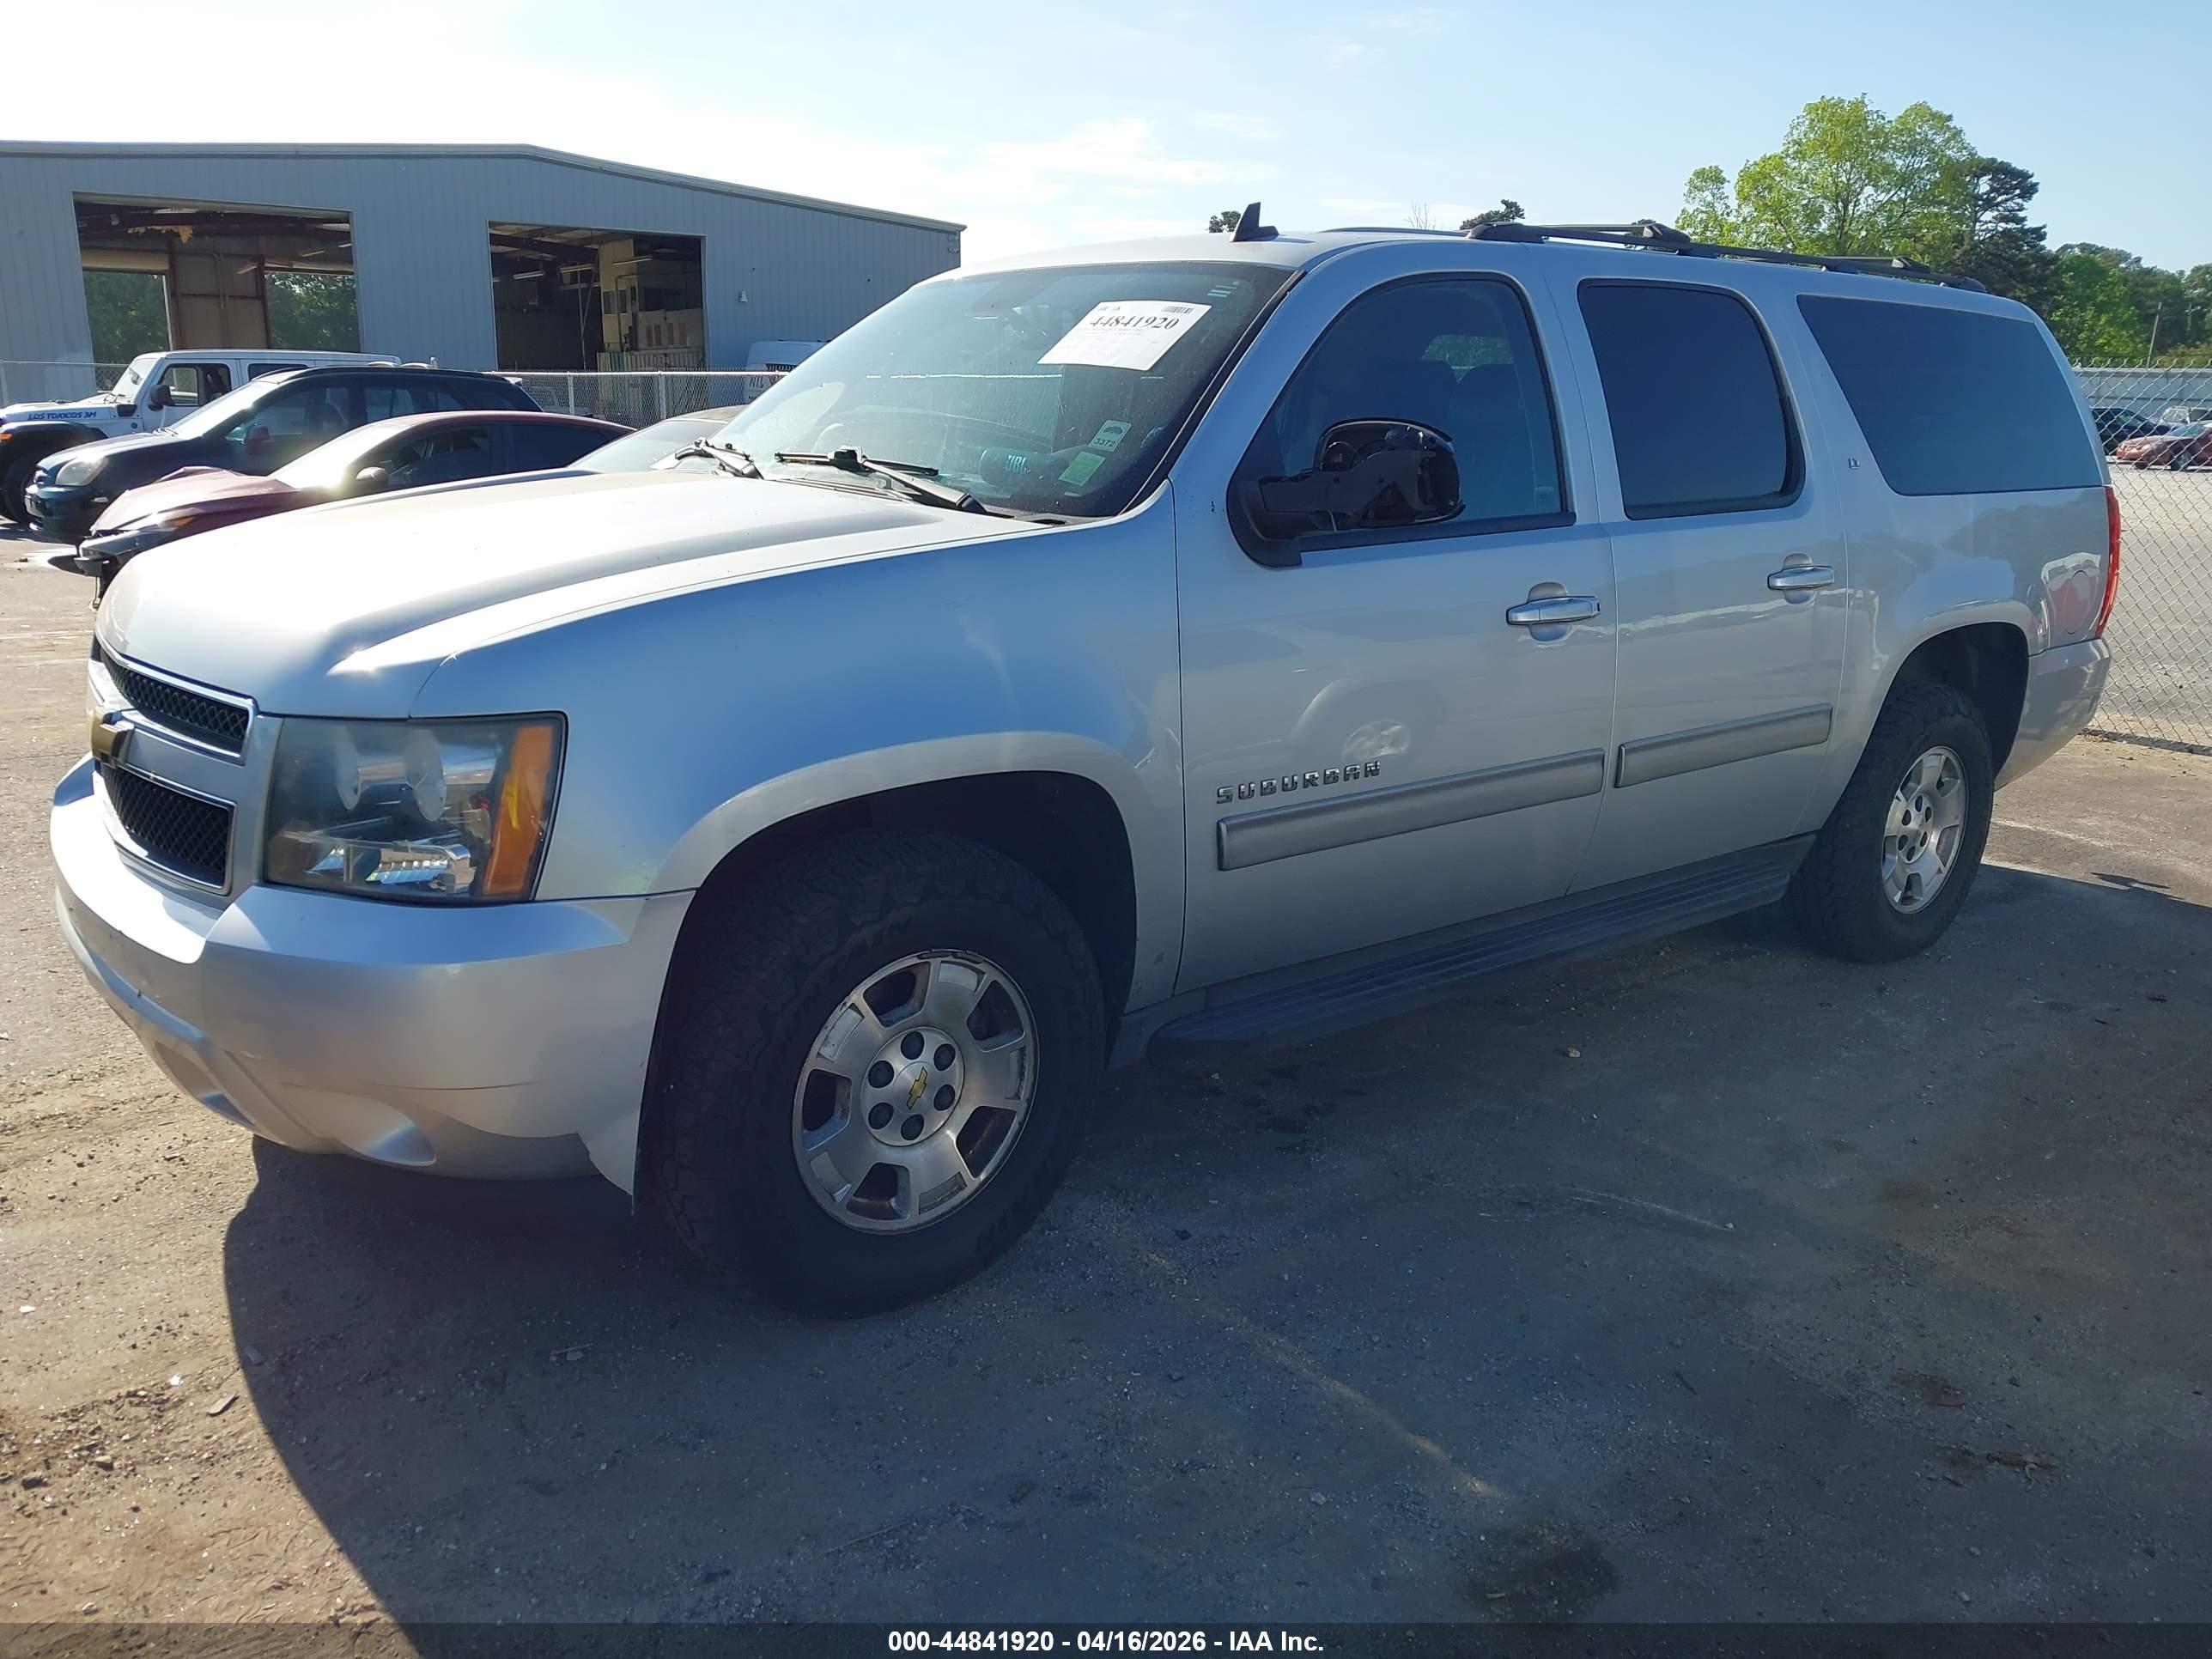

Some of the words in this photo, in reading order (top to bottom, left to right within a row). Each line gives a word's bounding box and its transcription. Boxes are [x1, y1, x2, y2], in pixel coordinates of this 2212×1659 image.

[1089, 315, 1181, 330] 44841920
[46, 411, 83, 420] TOXICOS
[1216, 760, 1382, 805] SUBURBAN
